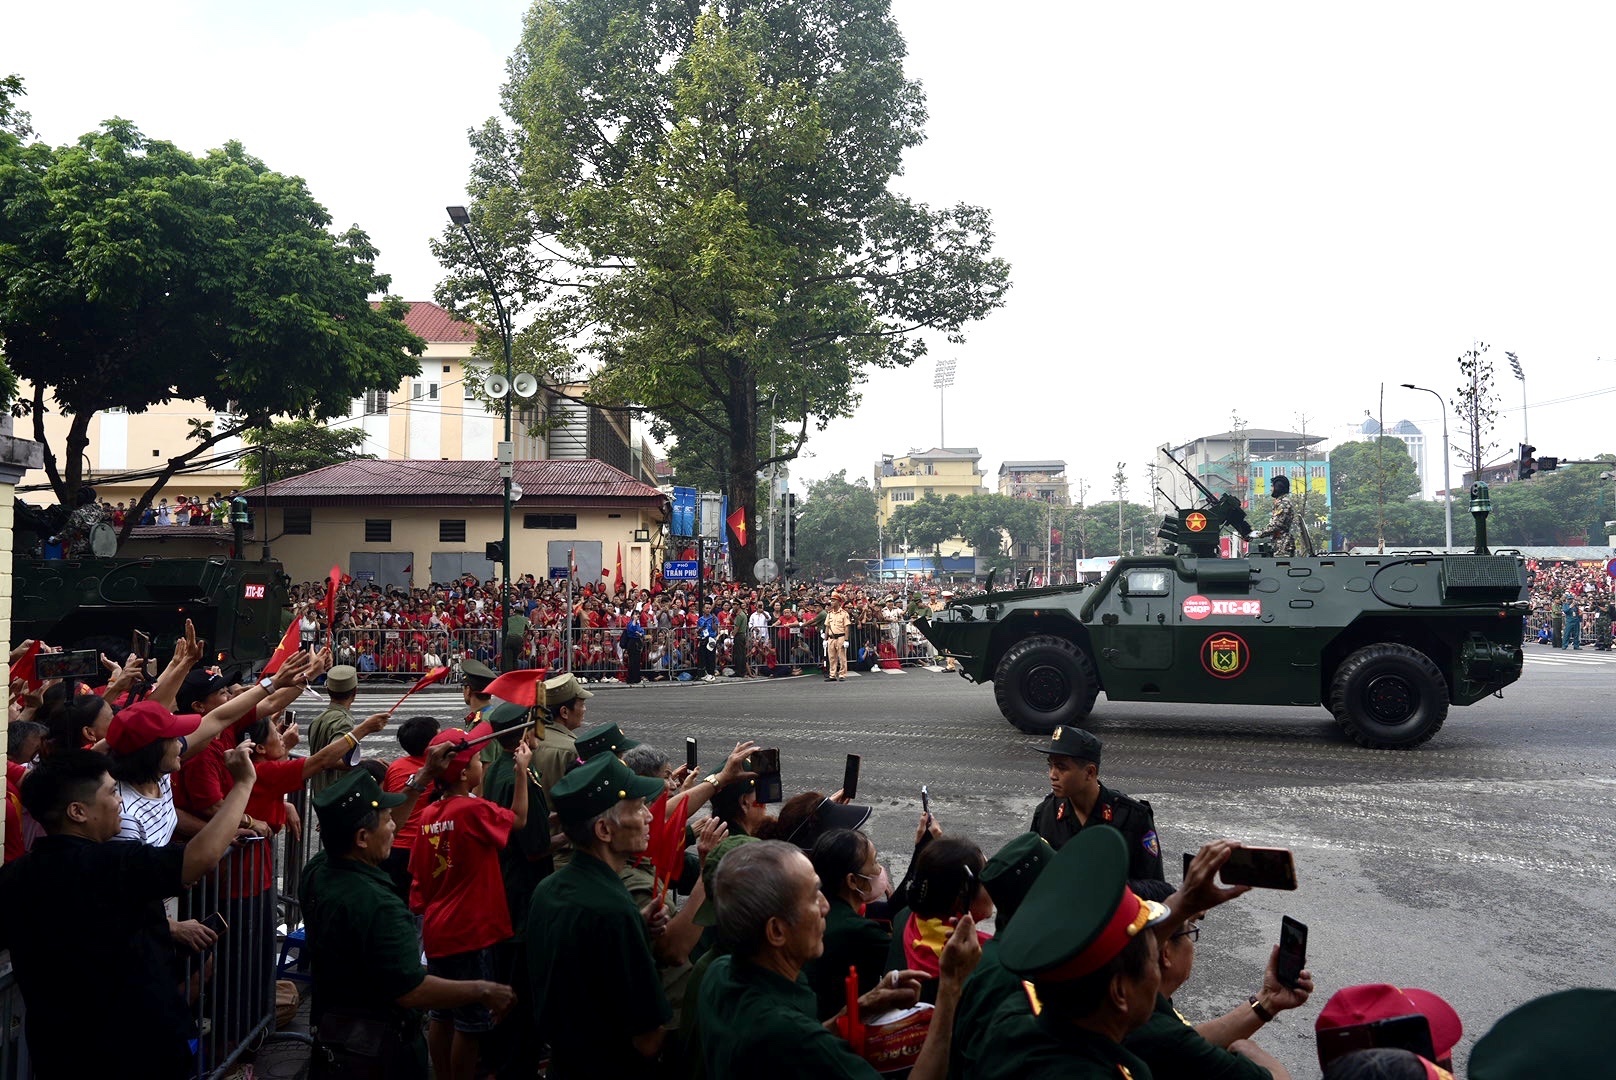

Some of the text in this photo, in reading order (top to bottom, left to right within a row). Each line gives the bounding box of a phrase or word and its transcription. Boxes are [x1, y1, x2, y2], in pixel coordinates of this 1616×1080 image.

[684, 568, 697, 577] PHÚ
[245, 586, 264, 597] XTC-02
[1212, 602, 1260, 614] XTC-02
